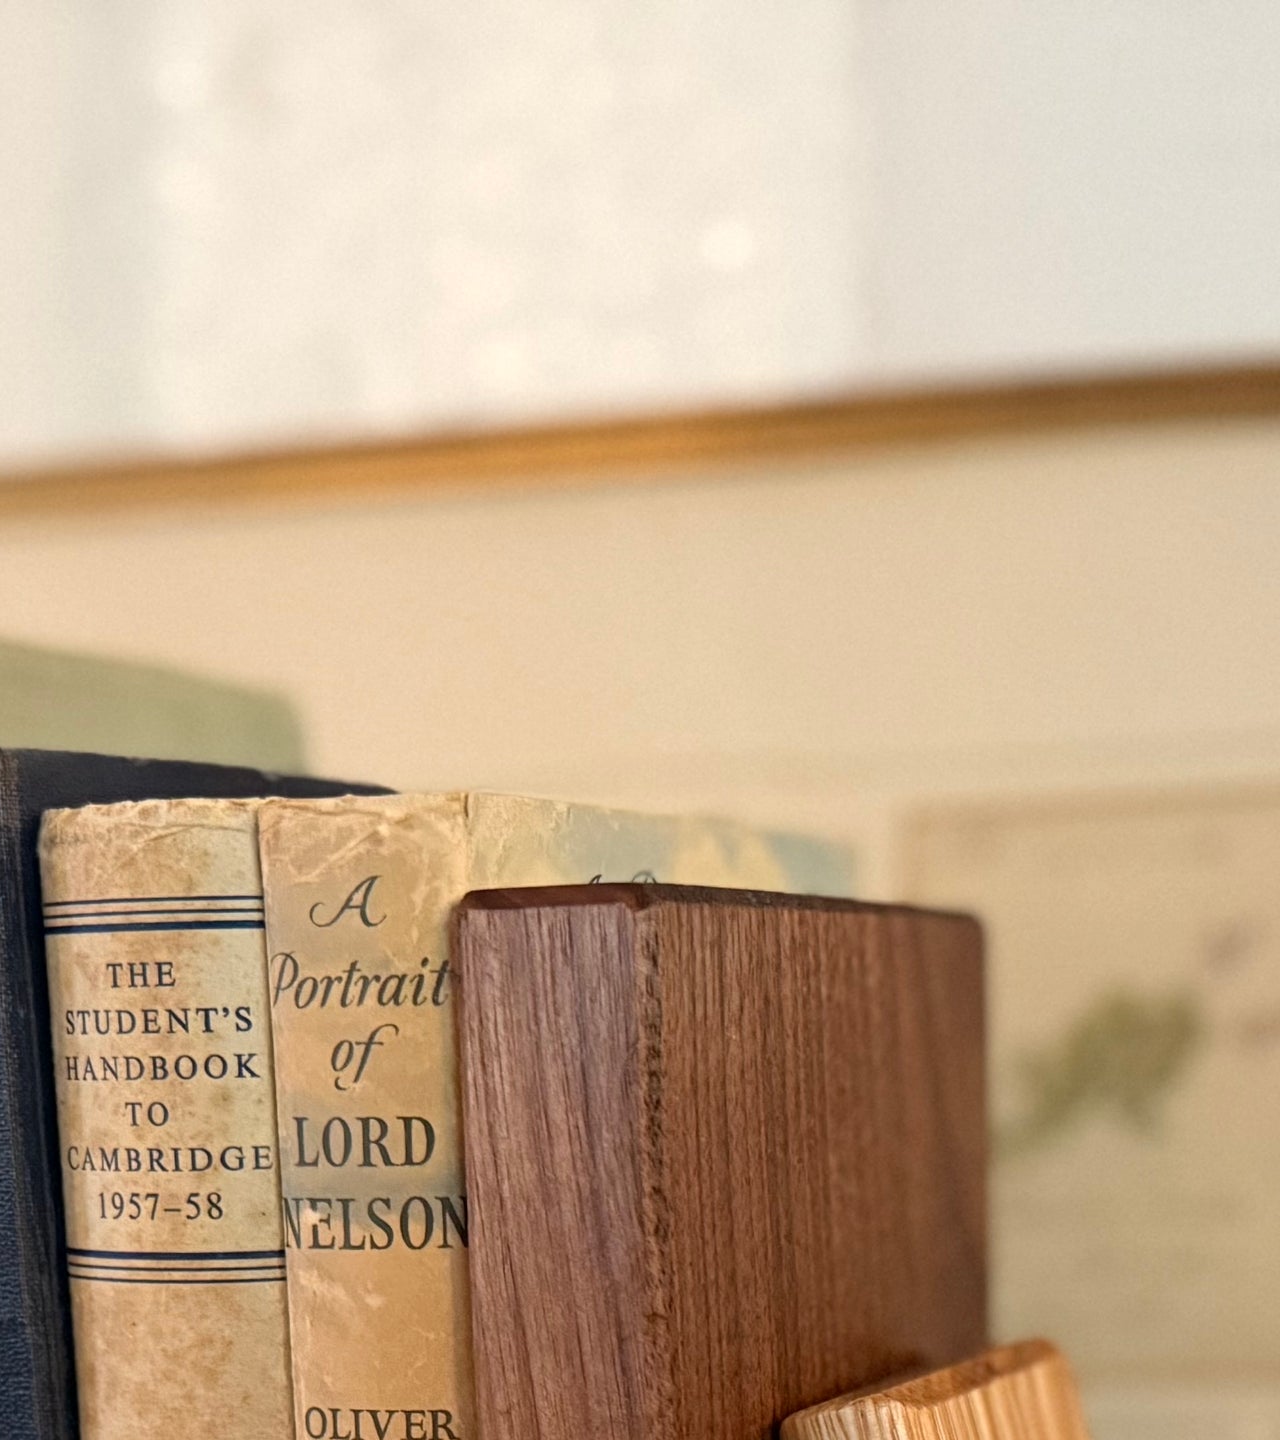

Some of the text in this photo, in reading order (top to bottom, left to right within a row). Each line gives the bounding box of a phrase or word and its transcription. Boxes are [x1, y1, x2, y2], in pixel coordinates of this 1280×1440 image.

[309, 875, 387, 928] A
[106, 961, 176, 989] THE
[271, 951, 452, 1009] Portrait
[65, 1006, 254, 1036] STUDENT'S
[65, 1053, 261, 1082] HANDBOOK
[330, 1024, 400, 1091] of
[125, 1101, 170, 1128] TO
[67, 1145, 274, 1173] CAMBRIDGE
[293, 1116, 436, 1168] LORD
[283, 1195, 469, 1251] NELSON
